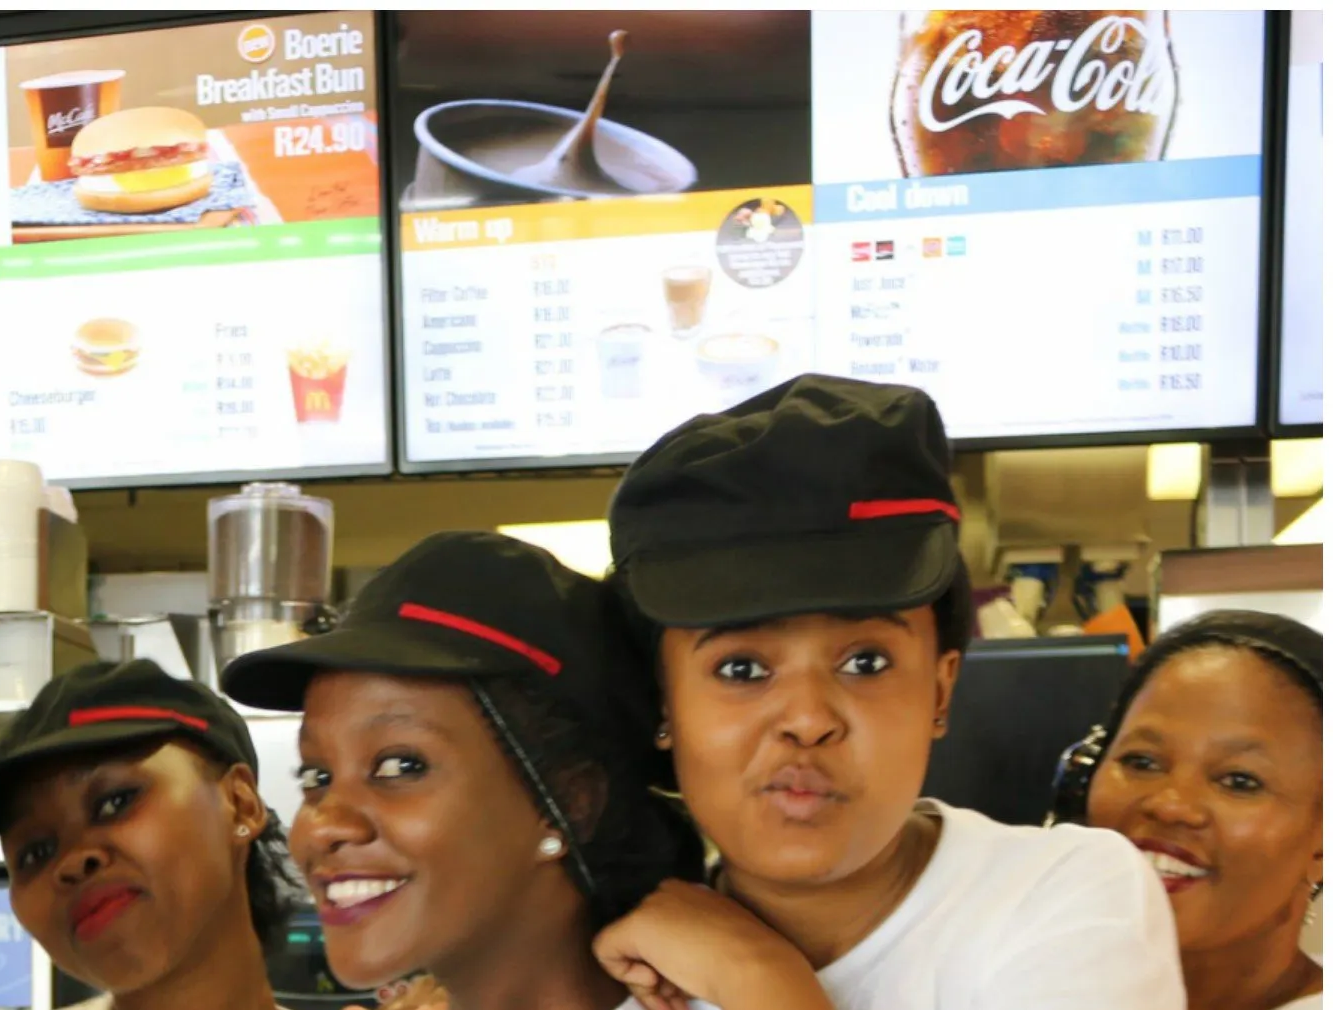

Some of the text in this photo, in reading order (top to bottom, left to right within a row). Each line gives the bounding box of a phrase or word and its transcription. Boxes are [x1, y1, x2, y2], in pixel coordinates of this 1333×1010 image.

[285, 23, 363, 60] Boerie
[196, 63, 365, 105] Breakfast Bun
[918, 15, 1163, 132] Coca-Cola
[274, 121, 365, 157] R24.90
[847, 180, 969, 212] Cool down
[414, 216, 478, 243] Warm
